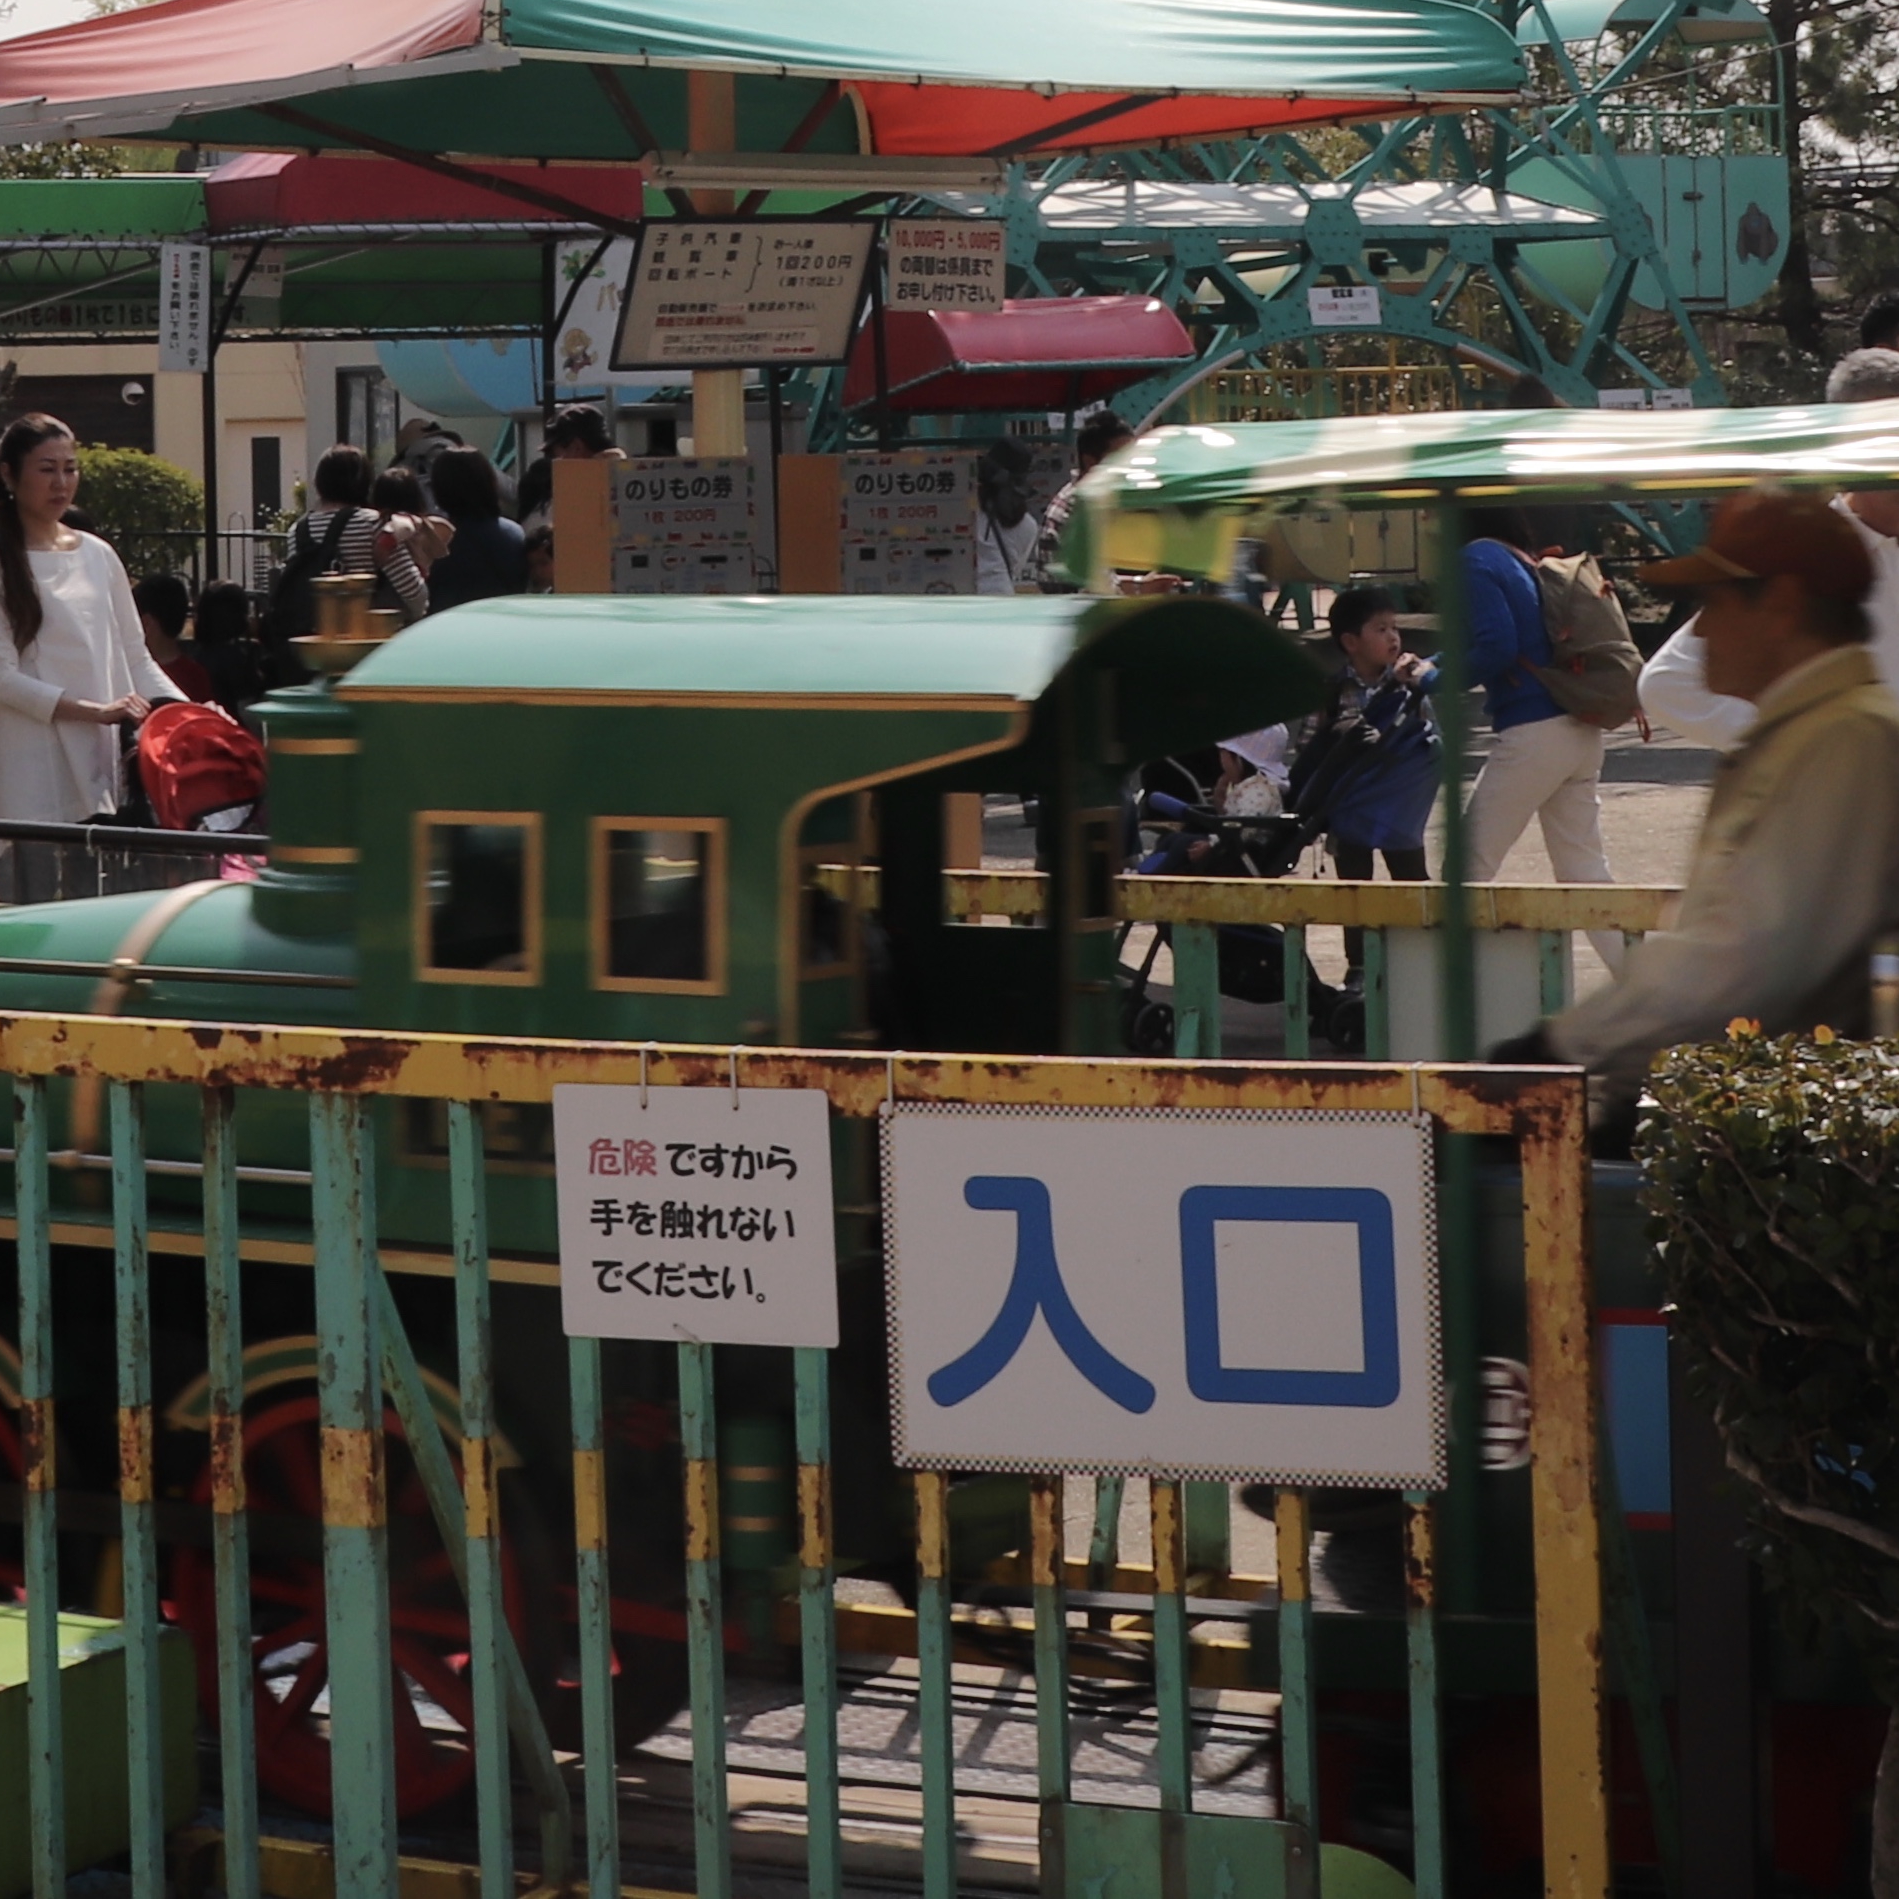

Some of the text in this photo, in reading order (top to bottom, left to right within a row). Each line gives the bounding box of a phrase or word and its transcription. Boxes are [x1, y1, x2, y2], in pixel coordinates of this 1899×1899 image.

[625, 475, 733, 500] のりもの券
[855, 471, 955, 495] のりもの券
[674, 508, 716, 522] 200円
[897, 505, 938, 518] 200円
[588, 1138, 798, 1181] 危険ですから
[590, 1199, 796, 1242] 手を触れない
[591, 1260, 768, 1304] でください。
[927, 1175, 1401, 1414] 入口
